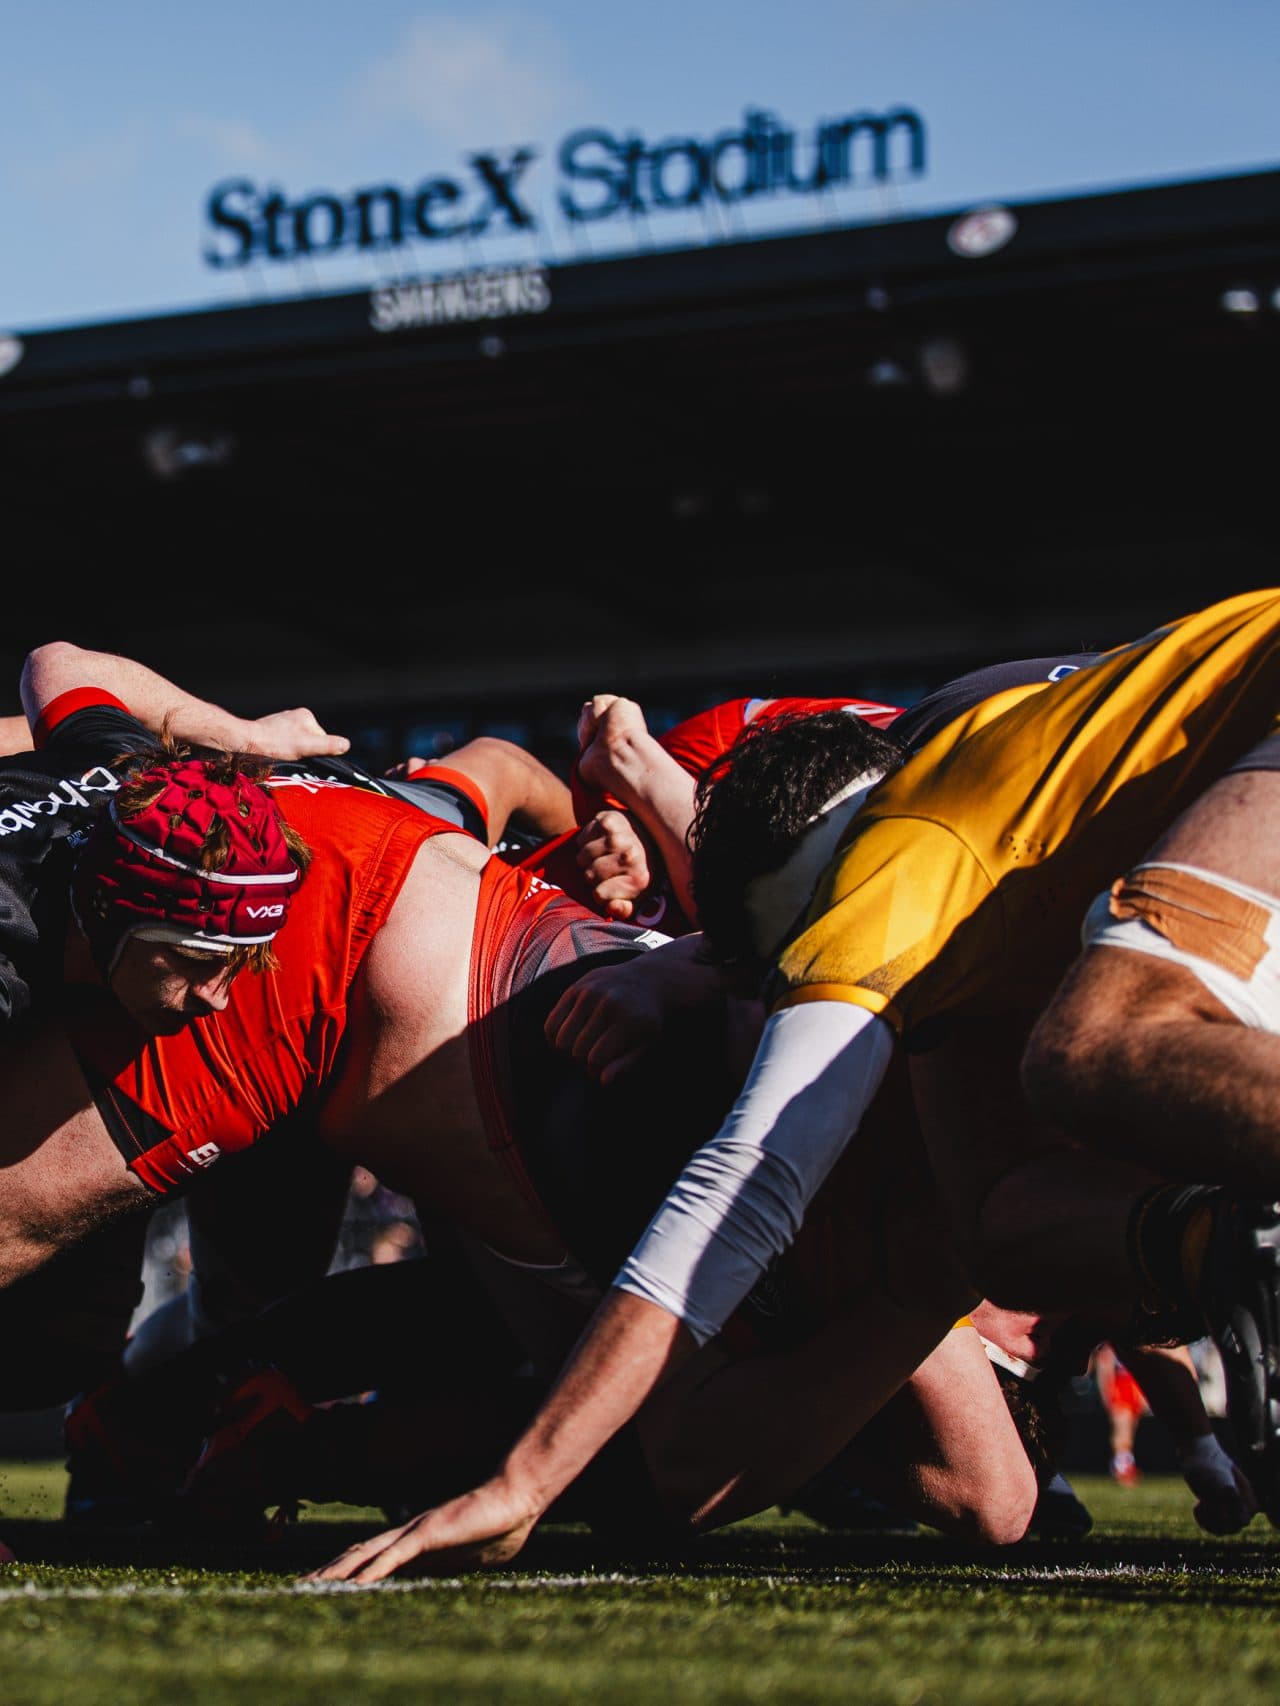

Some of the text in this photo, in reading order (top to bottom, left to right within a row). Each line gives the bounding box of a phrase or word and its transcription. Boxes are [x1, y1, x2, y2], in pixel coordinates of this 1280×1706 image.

[204, 105, 927, 270] StoneX Stadium
[246, 904, 284, 919] VX3
